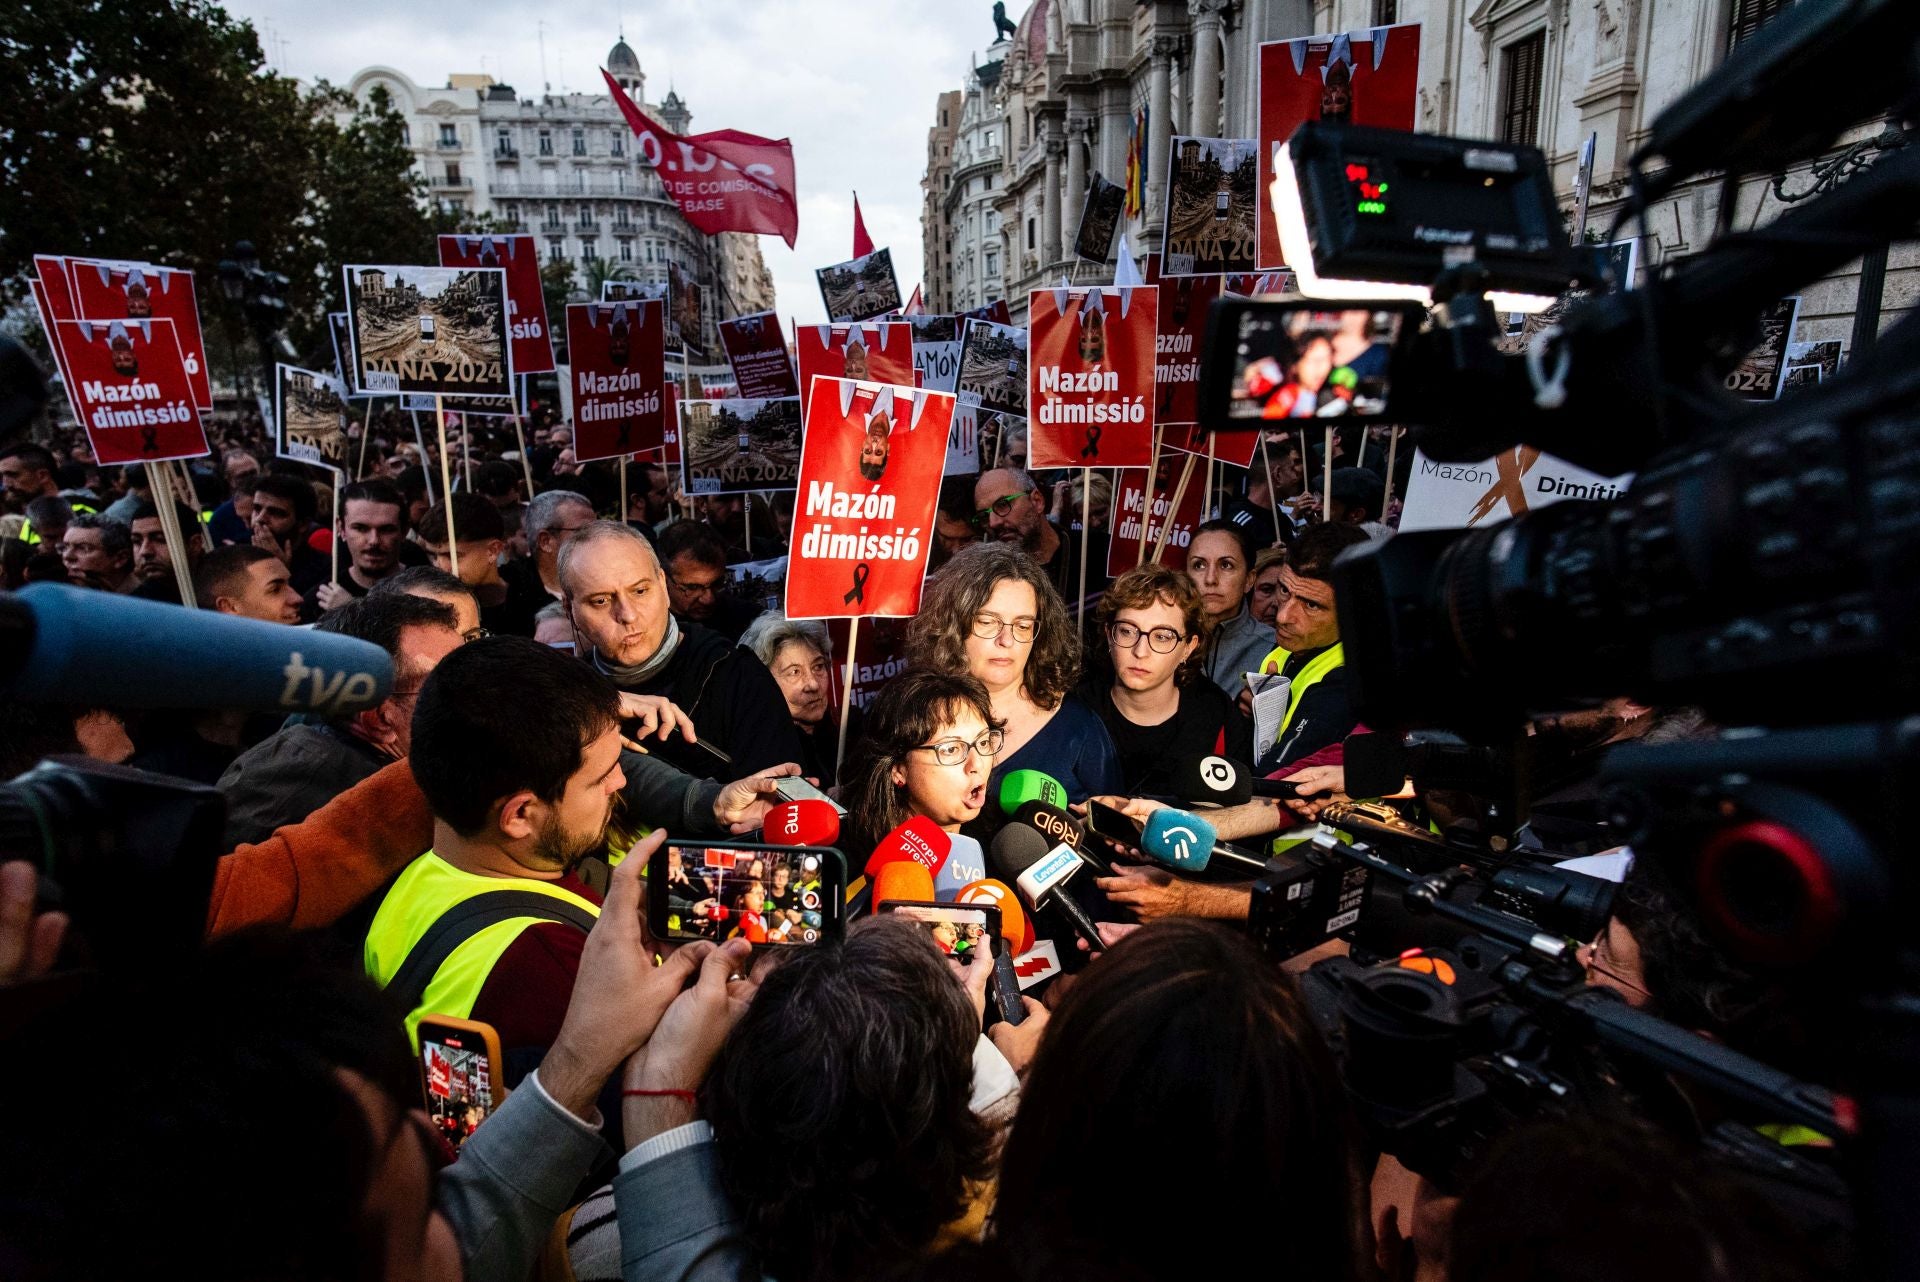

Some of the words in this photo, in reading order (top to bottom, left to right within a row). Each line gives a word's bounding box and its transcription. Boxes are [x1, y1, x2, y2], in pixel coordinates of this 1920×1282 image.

[675, 182, 695, 195] DE
[698, 179, 785, 203] COMISIONES
[686, 198, 725, 212] BASE
[1168, 239, 1225, 262] DANA
[831, 303, 870, 319] DANA
[872, 292, 898, 311] 2024
[1157, 328, 1193, 353] azón
[185, 352, 199, 375] ó
[362, 358, 438, 382] DANA
[444, 360, 503, 385] 2024
[82, 378, 161, 404] Mazón
[579, 368, 641, 396] Mazón
[1039, 364, 1118, 393] Mazón
[1725, 373, 1772, 392] 024
[581, 390, 660, 423] dimissió
[960, 381, 1010, 406] DANA
[91, 400, 191, 429] dimissió
[1039, 396, 1145, 424] dimissió
[690, 466, 750, 484] DANA
[754, 464, 798, 481] 2024
[1421, 460, 1492, 485] Mazón
[806, 480, 897, 520] Mazón
[801, 524, 921, 562] dimissió
[784, 804, 799, 835] rne
[904, 829, 938, 864] europa
[951, 859, 981, 882] tve
